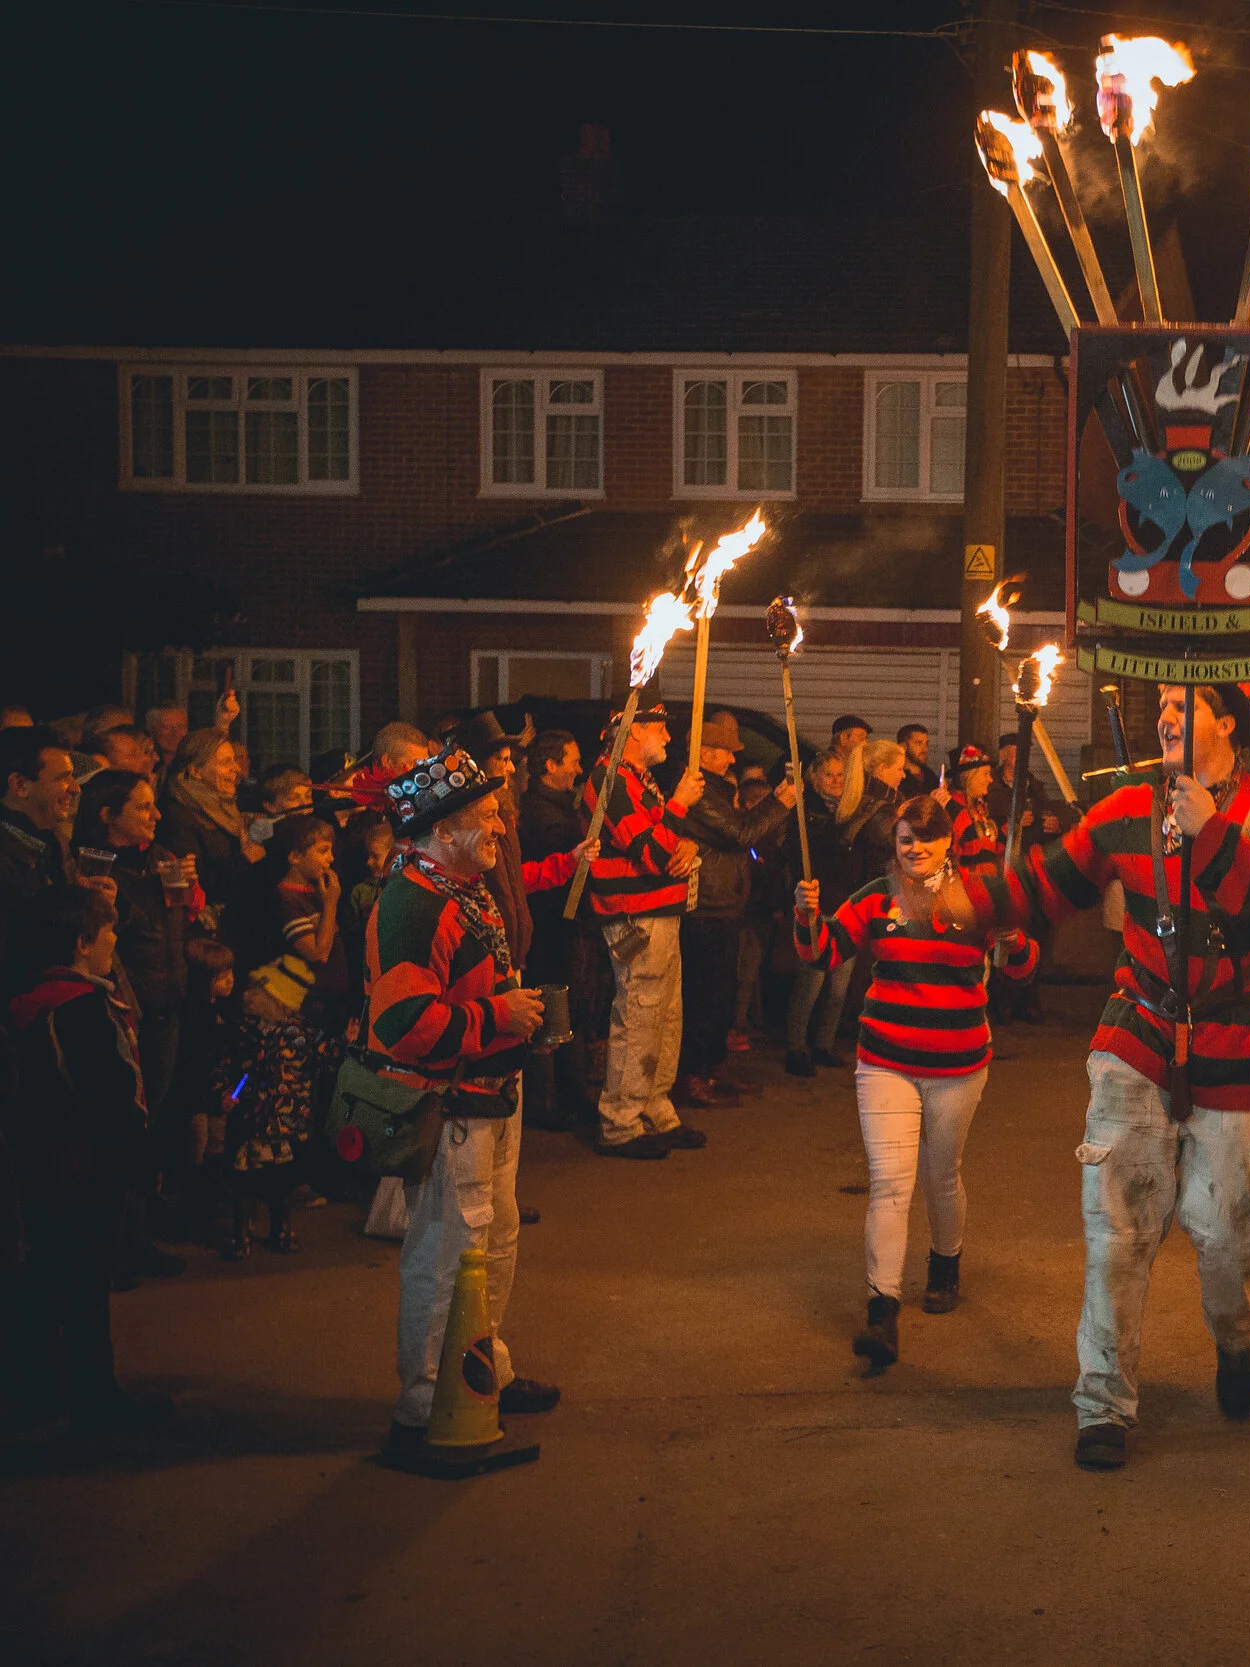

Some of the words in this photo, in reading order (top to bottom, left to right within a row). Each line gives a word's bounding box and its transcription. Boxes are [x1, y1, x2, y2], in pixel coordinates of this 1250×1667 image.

[1139, 612, 1217, 630] ISFIELD
[1225, 613, 1240, 630] &
[1110, 655, 1177, 679] LITTLE
